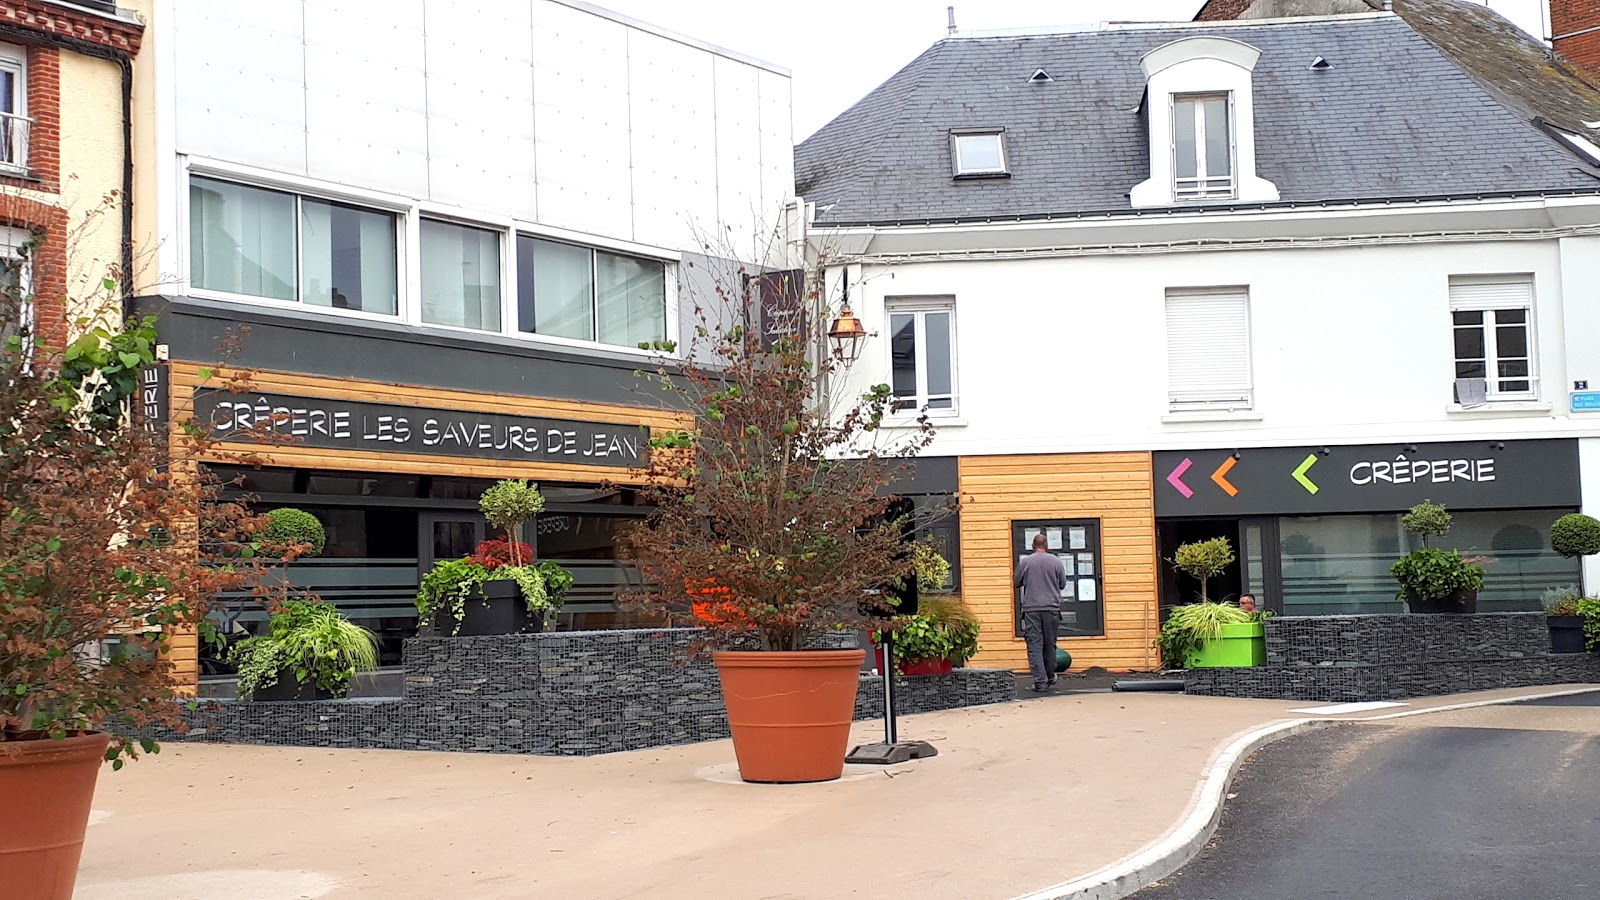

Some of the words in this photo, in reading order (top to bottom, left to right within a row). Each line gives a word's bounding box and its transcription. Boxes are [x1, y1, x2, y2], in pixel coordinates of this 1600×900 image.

[1578, 381, 1584, 389] 2
[211, 396, 350, 437] CRÊPERIE
[363, 415, 411, 442] LES
[422, 419, 540, 451] SAVEURS
[547, 429, 577, 454] DE
[583, 433, 637, 459] JEAN
[1350, 454, 1496, 485] CRÊPERIE
